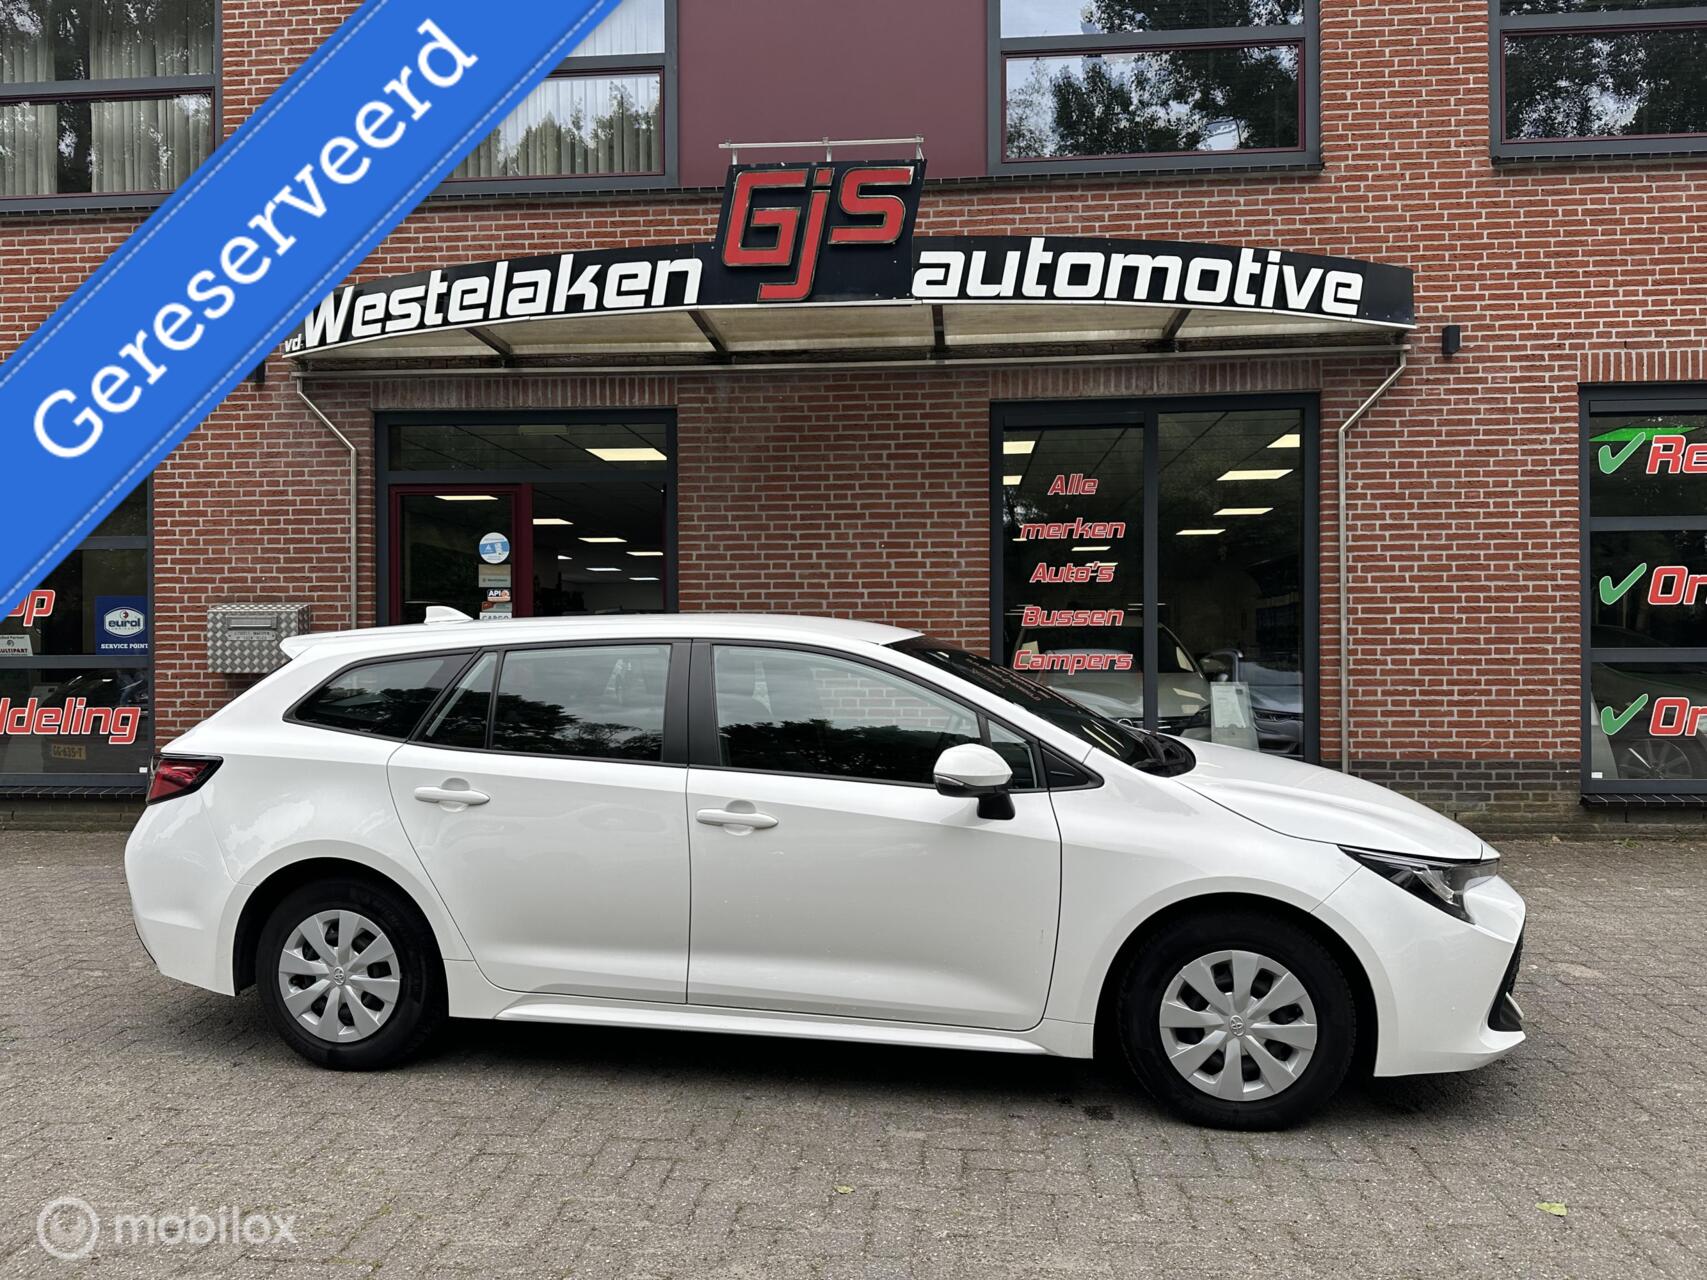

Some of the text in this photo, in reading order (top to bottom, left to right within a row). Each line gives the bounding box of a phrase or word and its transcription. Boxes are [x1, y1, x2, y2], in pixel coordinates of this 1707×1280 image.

[304, 254, 703, 348] Westelaken
[911, 237, 1364, 316] automotive
[1646, 434, 1707, 474] Re
[1047, 473, 1098, 495] Alle
[1020, 517, 1126, 539] merken
[1029, 561, 1115, 583] Auto's
[108, 617, 140, 628] eurol
[1021, 606, 1124, 627] Bussen
[1013, 650, 1133, 675] Campers
